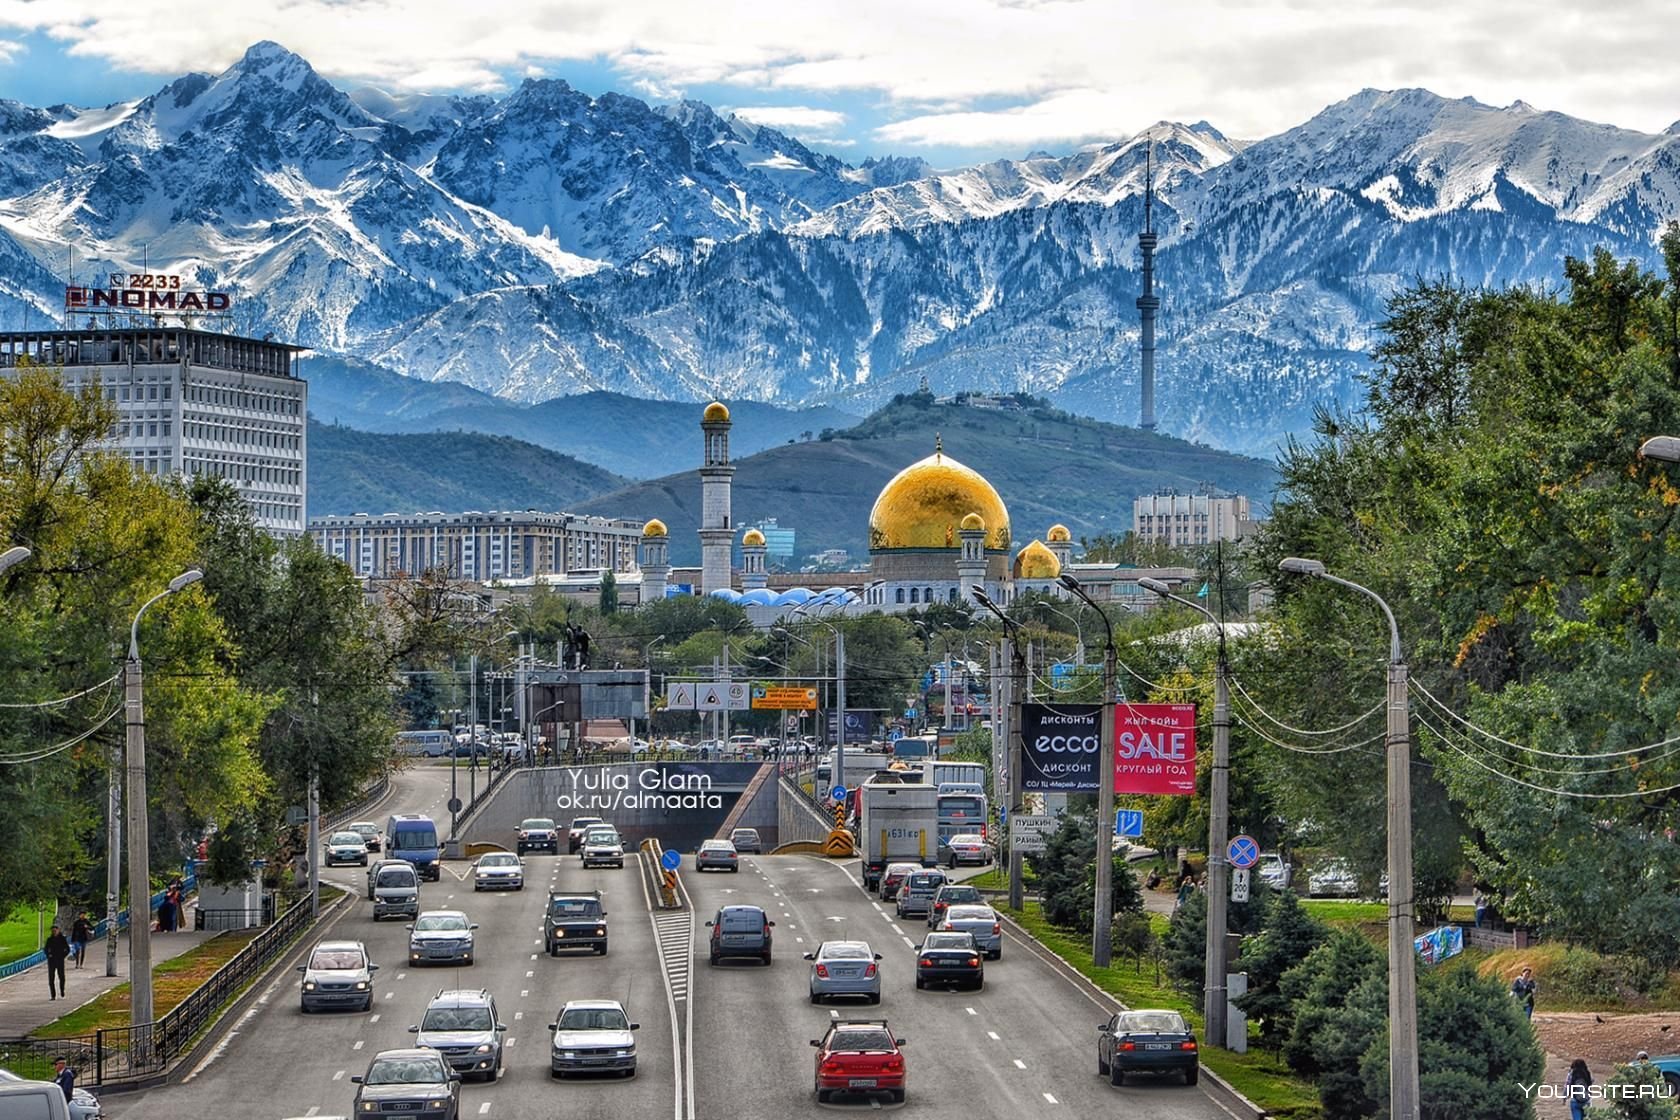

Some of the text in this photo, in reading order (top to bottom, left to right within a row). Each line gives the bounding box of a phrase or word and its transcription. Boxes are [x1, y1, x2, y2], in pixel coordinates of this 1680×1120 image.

[130, 274, 180, 289] 2233
[93, 289, 230, 310] NOMAD
[1040, 715, 1094, 725] ДИСКОНТЫ
[1124, 716, 1179, 725] ЖЫЛ БОЙЫ
[1035, 734, 1099, 753] ecco
[1119, 732, 1186, 759] SALE
[1042, 763, 1092, 773] ДИСКОНТ
[1116, 764, 1187, 775] КРУГЛЫЙ ГОД
[1015, 819, 1051, 827] ПУШКИН
[1234, 883, 1247, 892] 200
